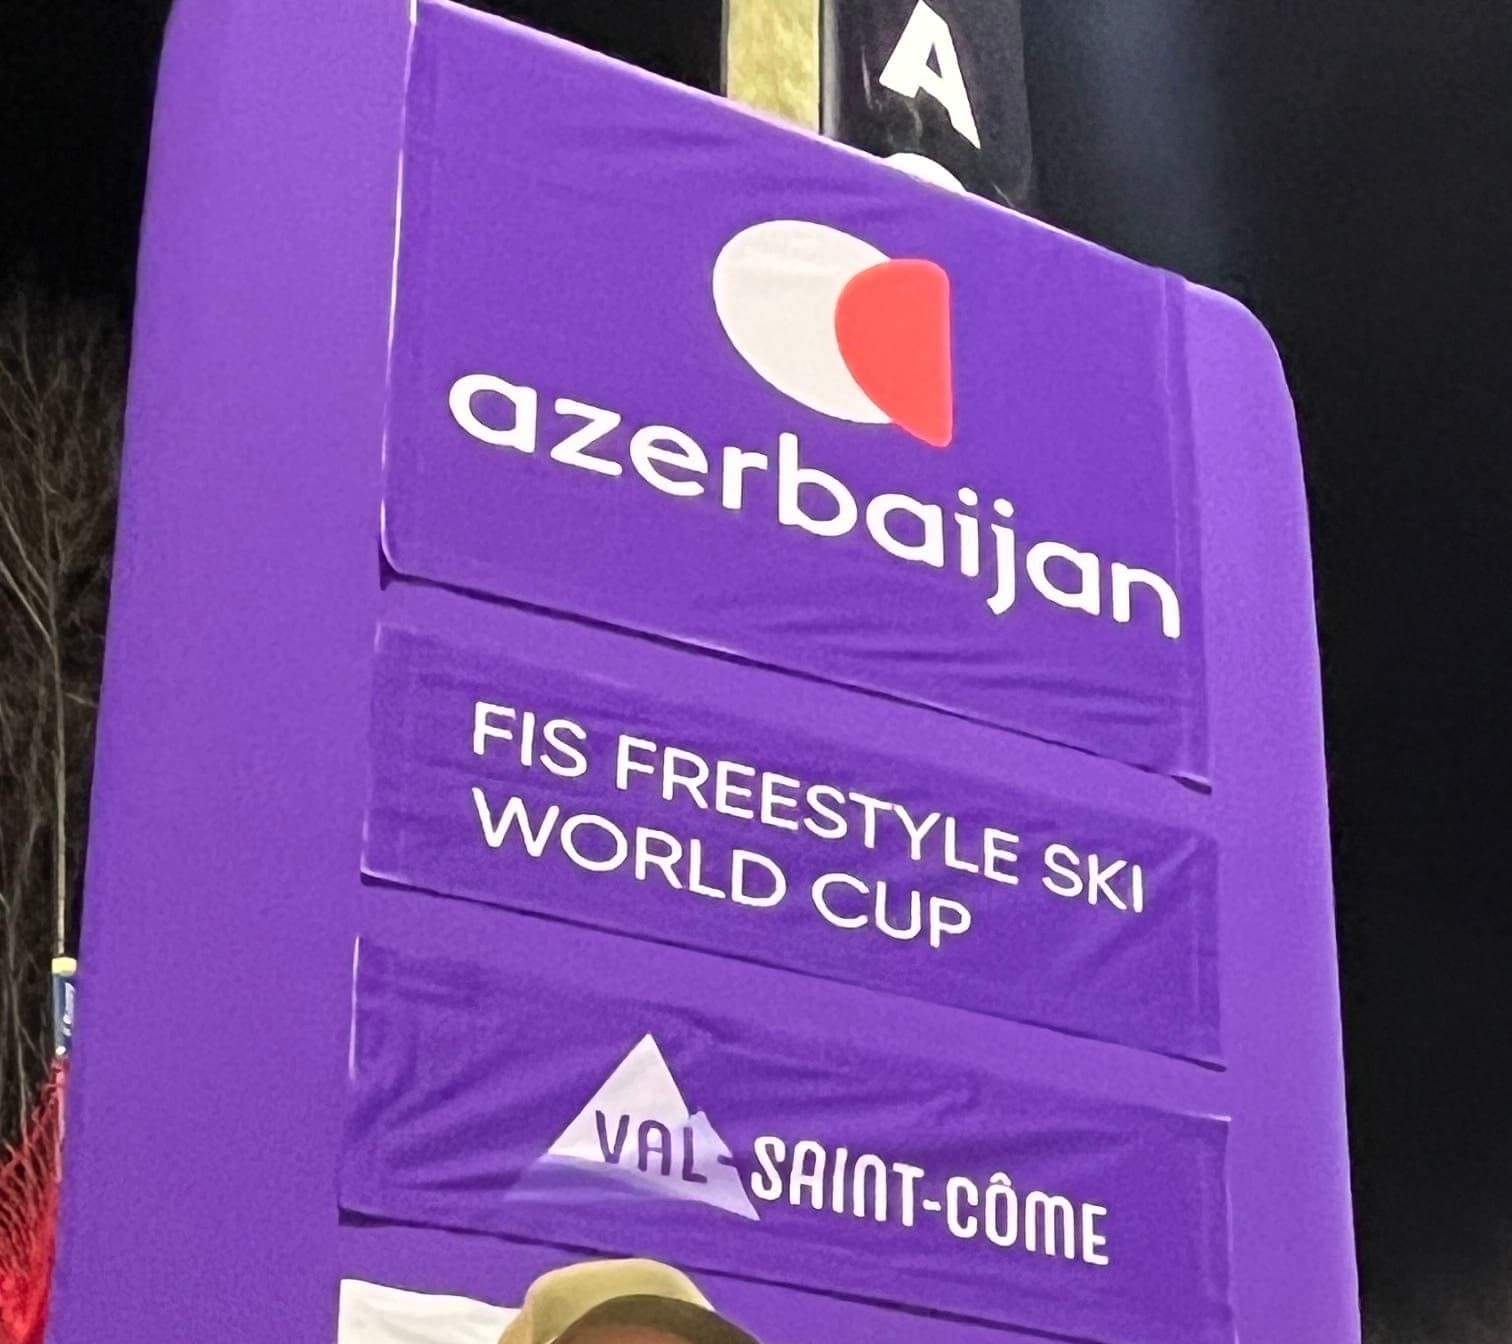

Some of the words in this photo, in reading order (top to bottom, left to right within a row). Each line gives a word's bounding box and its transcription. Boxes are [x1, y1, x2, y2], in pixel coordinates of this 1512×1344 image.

[449, 374, 1180, 639] azerbaijan
[472, 788, 786, 907] WORLD
[812, 873, 972, 948] CUP
[473, 702, 588, 777] FIS
[617, 735, 1019, 885] FREESTYLE
[1041, 844, 1144, 912] SKI
